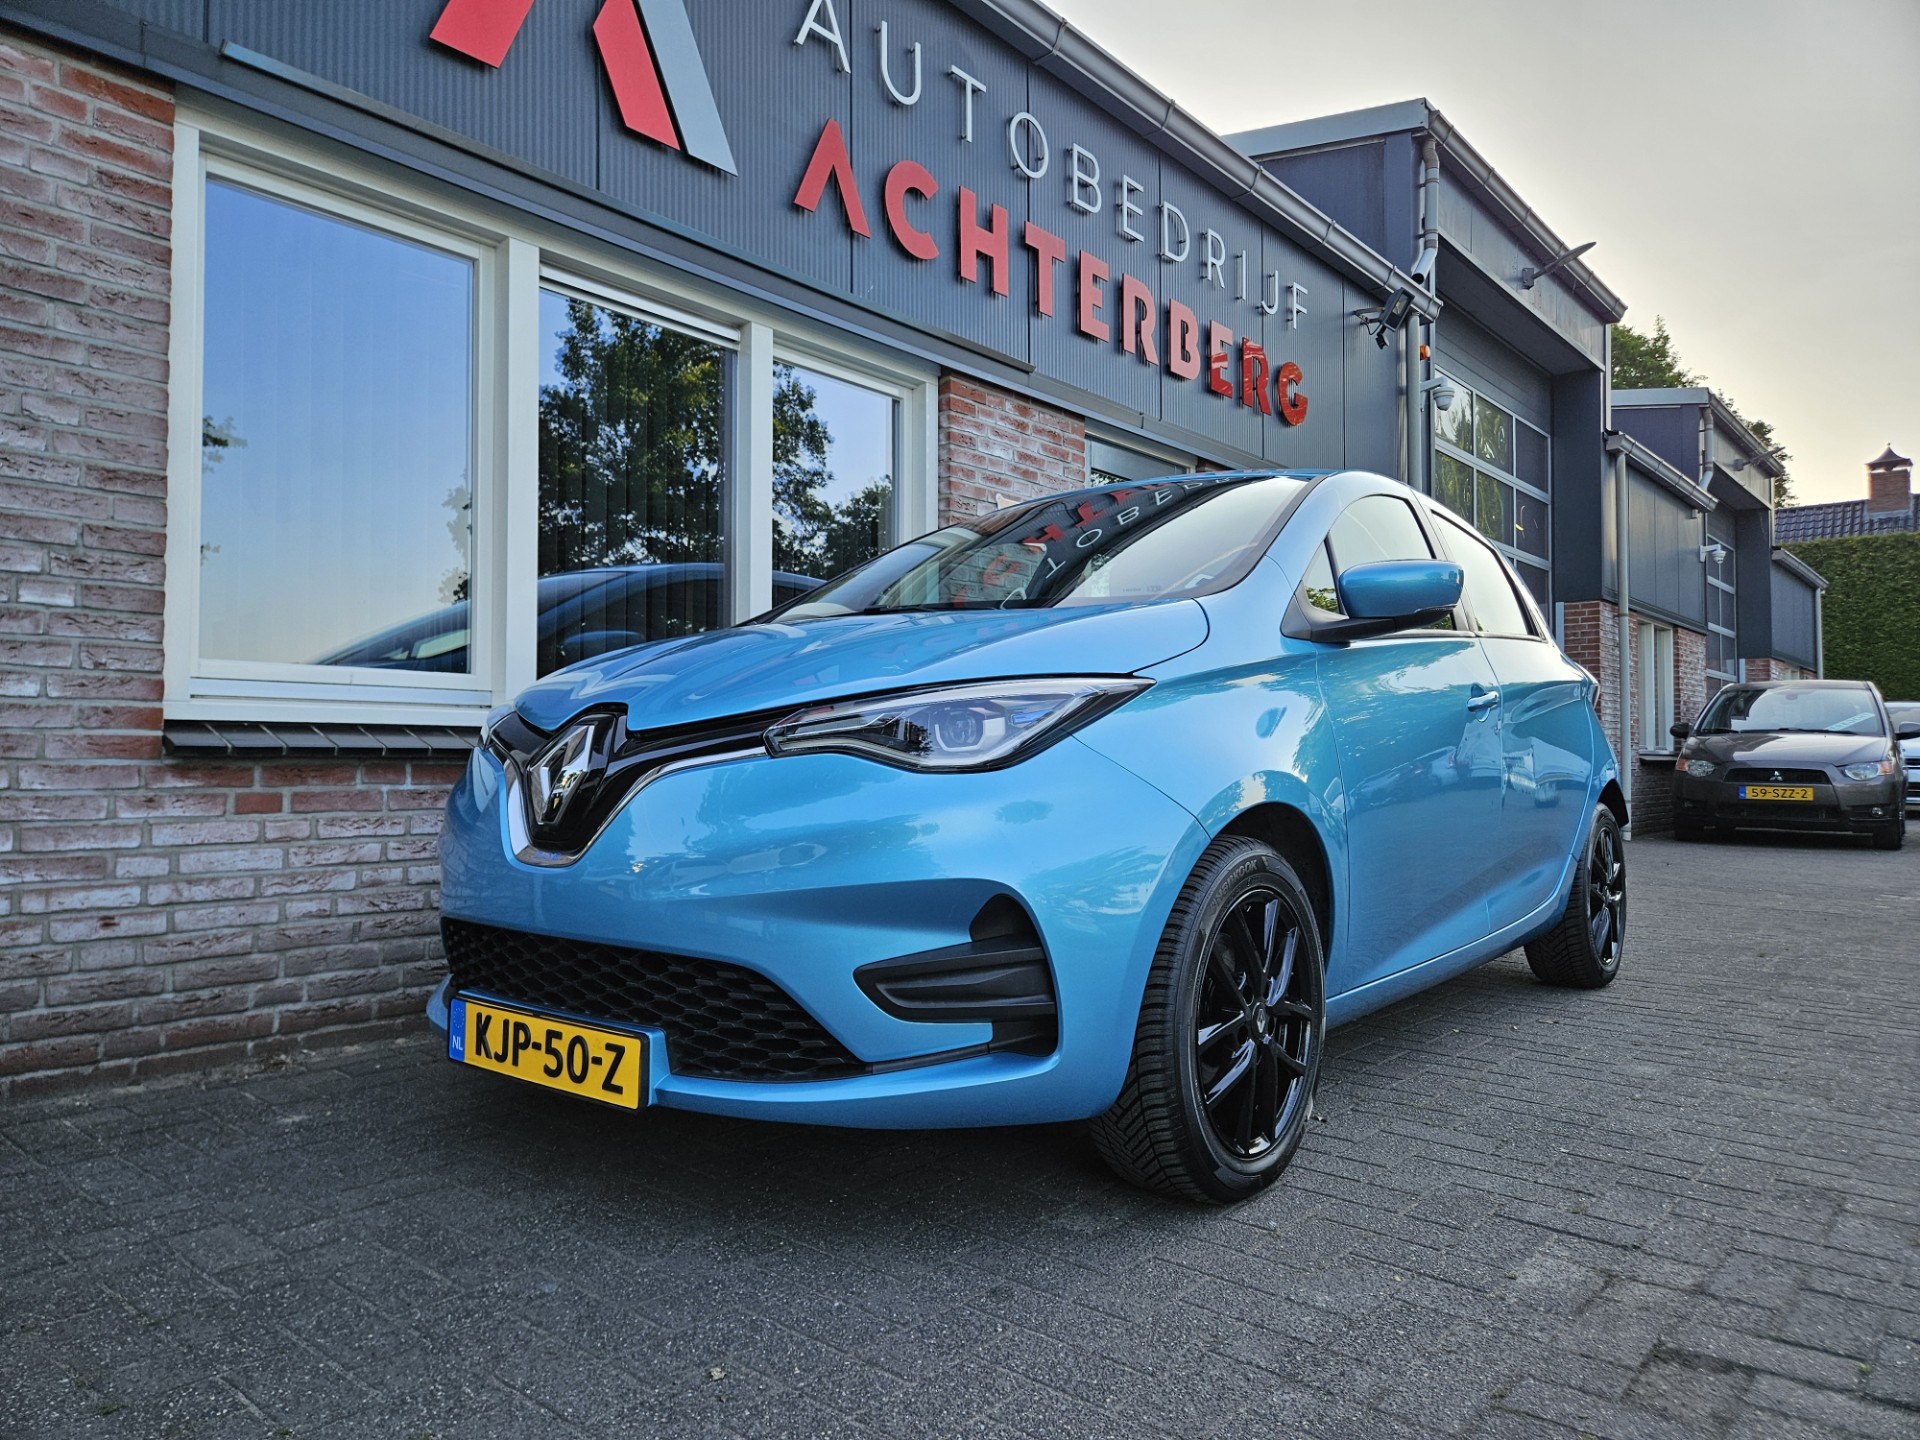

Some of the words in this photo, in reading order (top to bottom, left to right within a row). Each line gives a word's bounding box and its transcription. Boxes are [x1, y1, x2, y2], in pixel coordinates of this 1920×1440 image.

[795, 0, 1308, 329] AUTOBEDRIJF
[794, 118, 1309, 427] ACHTERBERG
[1751, 788, 1808, 799] 59-SZZ-2
[452, 1035, 463, 1051] NL
[475, 1011, 625, 1095] KJP-50-Z
